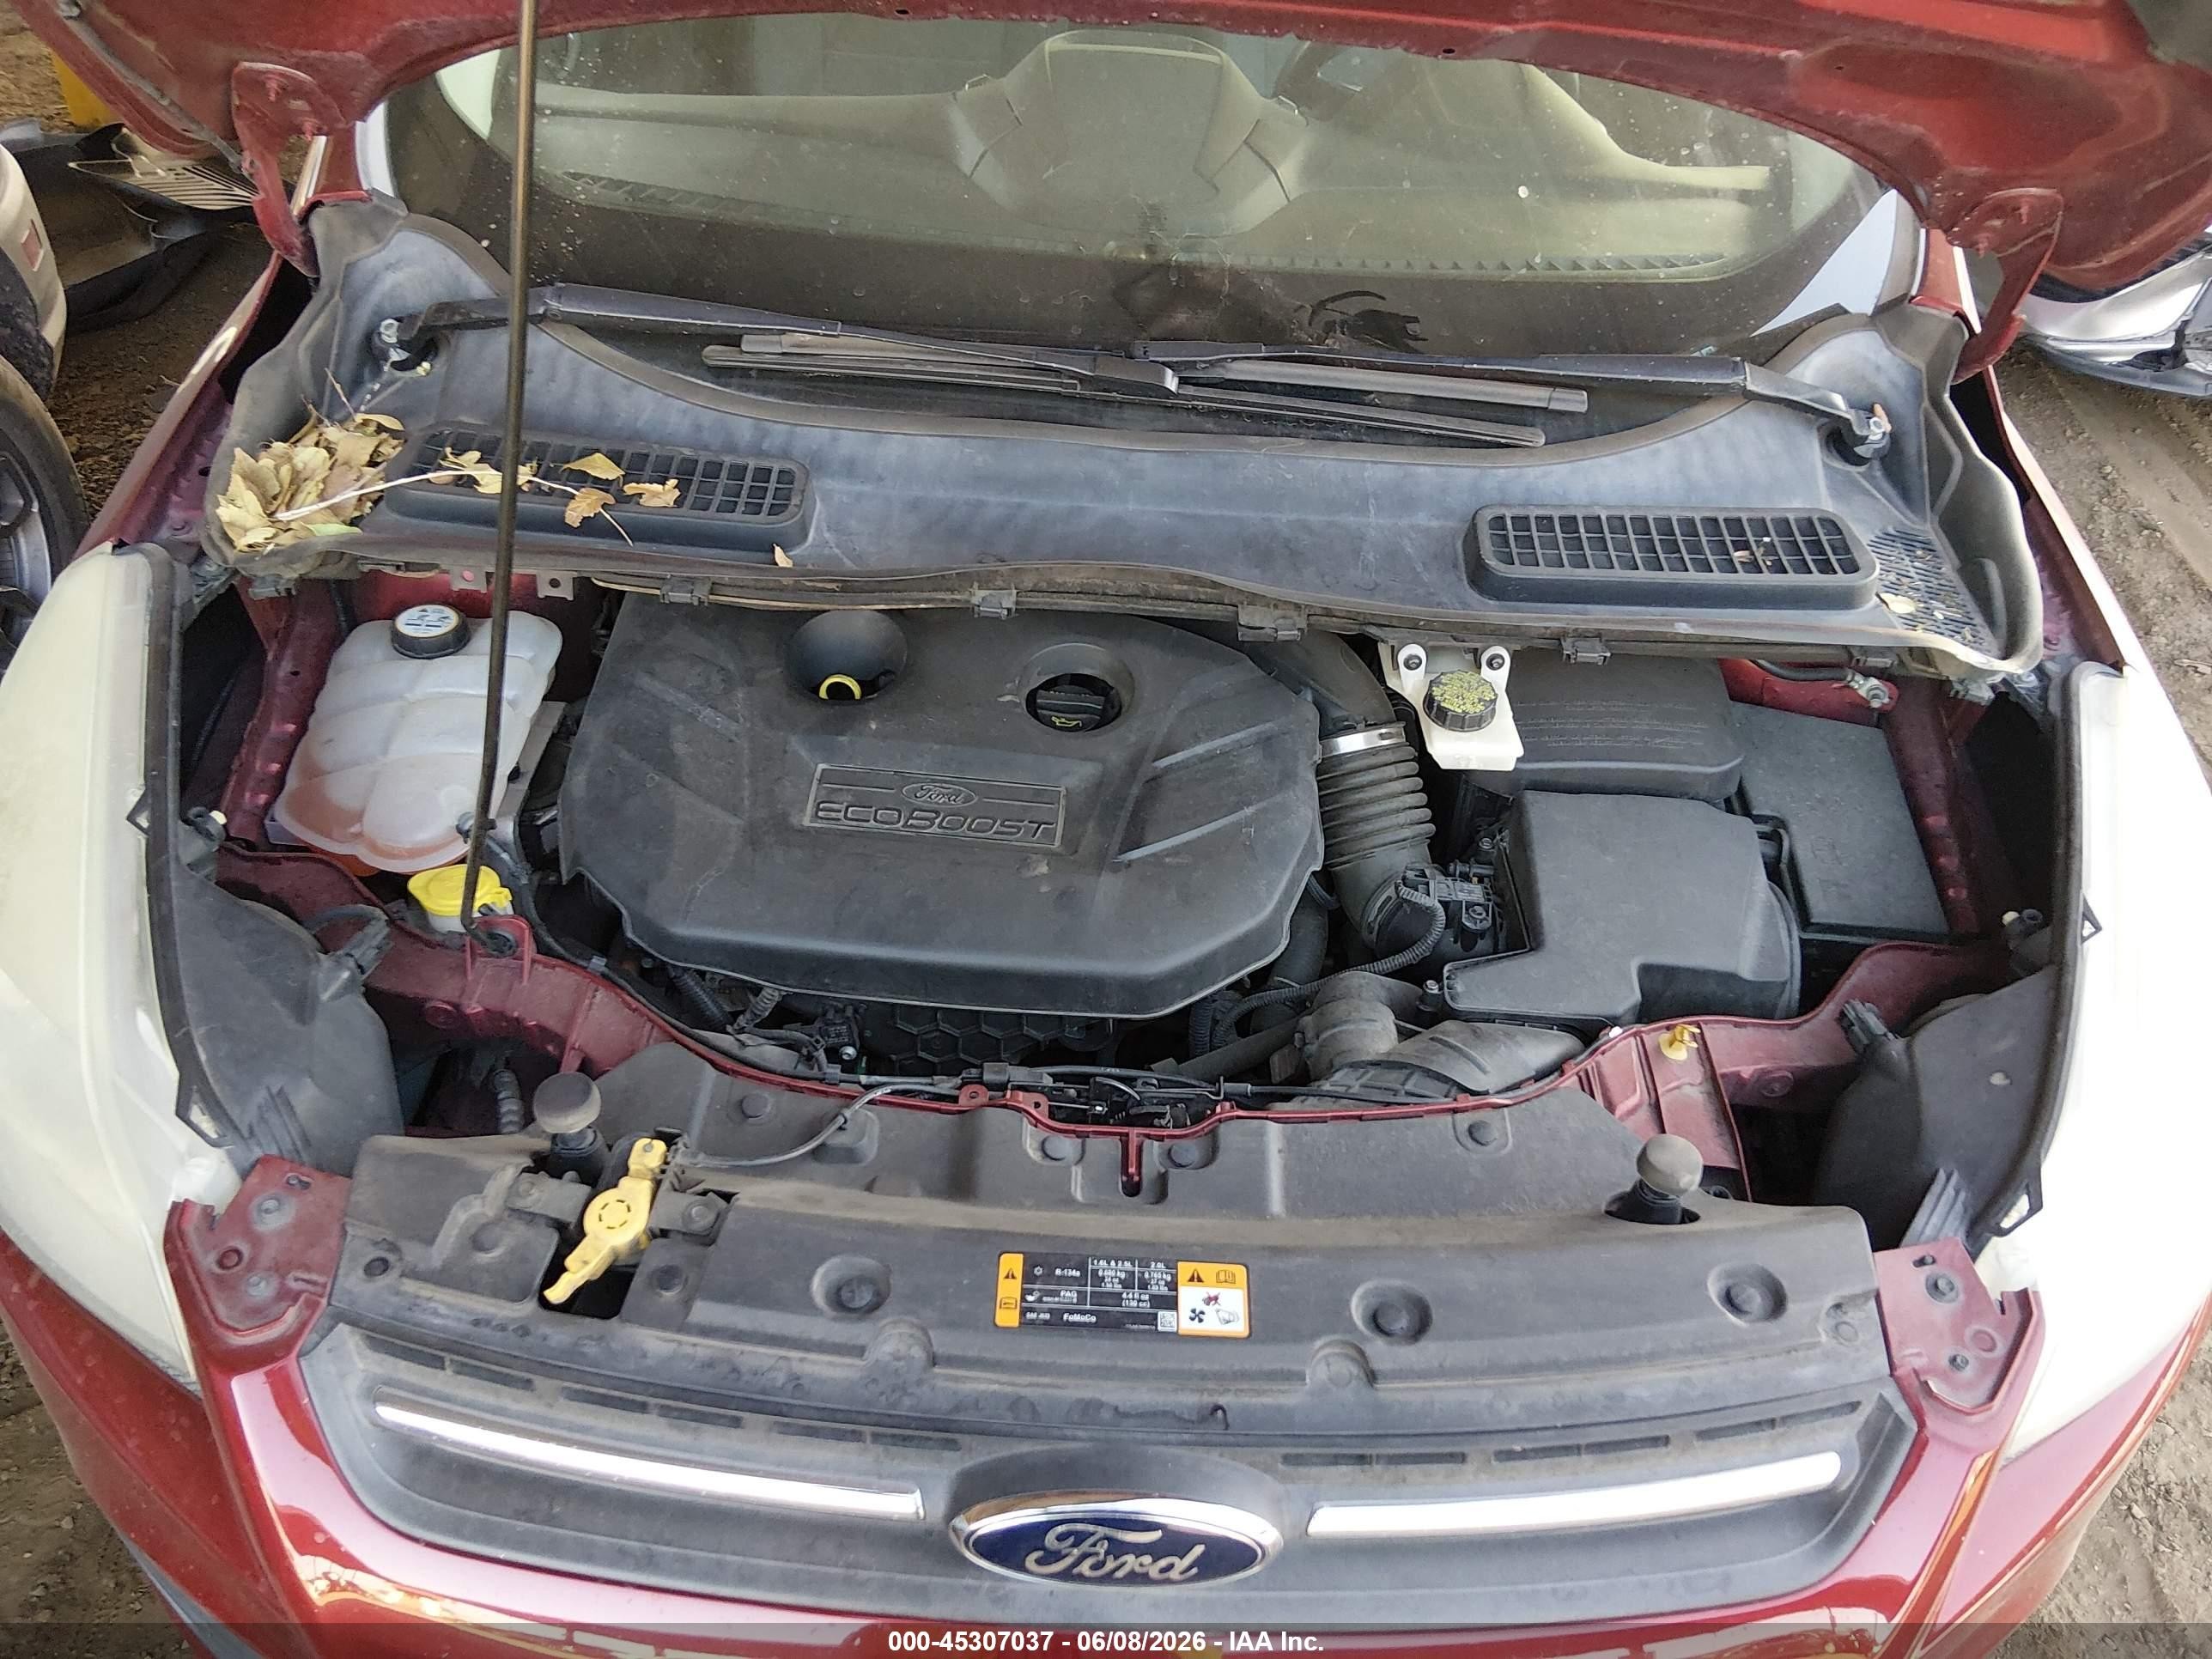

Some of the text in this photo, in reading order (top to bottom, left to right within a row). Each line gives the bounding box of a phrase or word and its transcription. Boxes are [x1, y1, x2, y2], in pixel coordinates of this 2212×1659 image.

[915, 785, 963, 805] Ford
[817, 800, 1055, 839] ECOBOOST
[1063, 1313, 1097, 1323] FoMoCo
[1024, 1522, 1206, 1581] Ford
